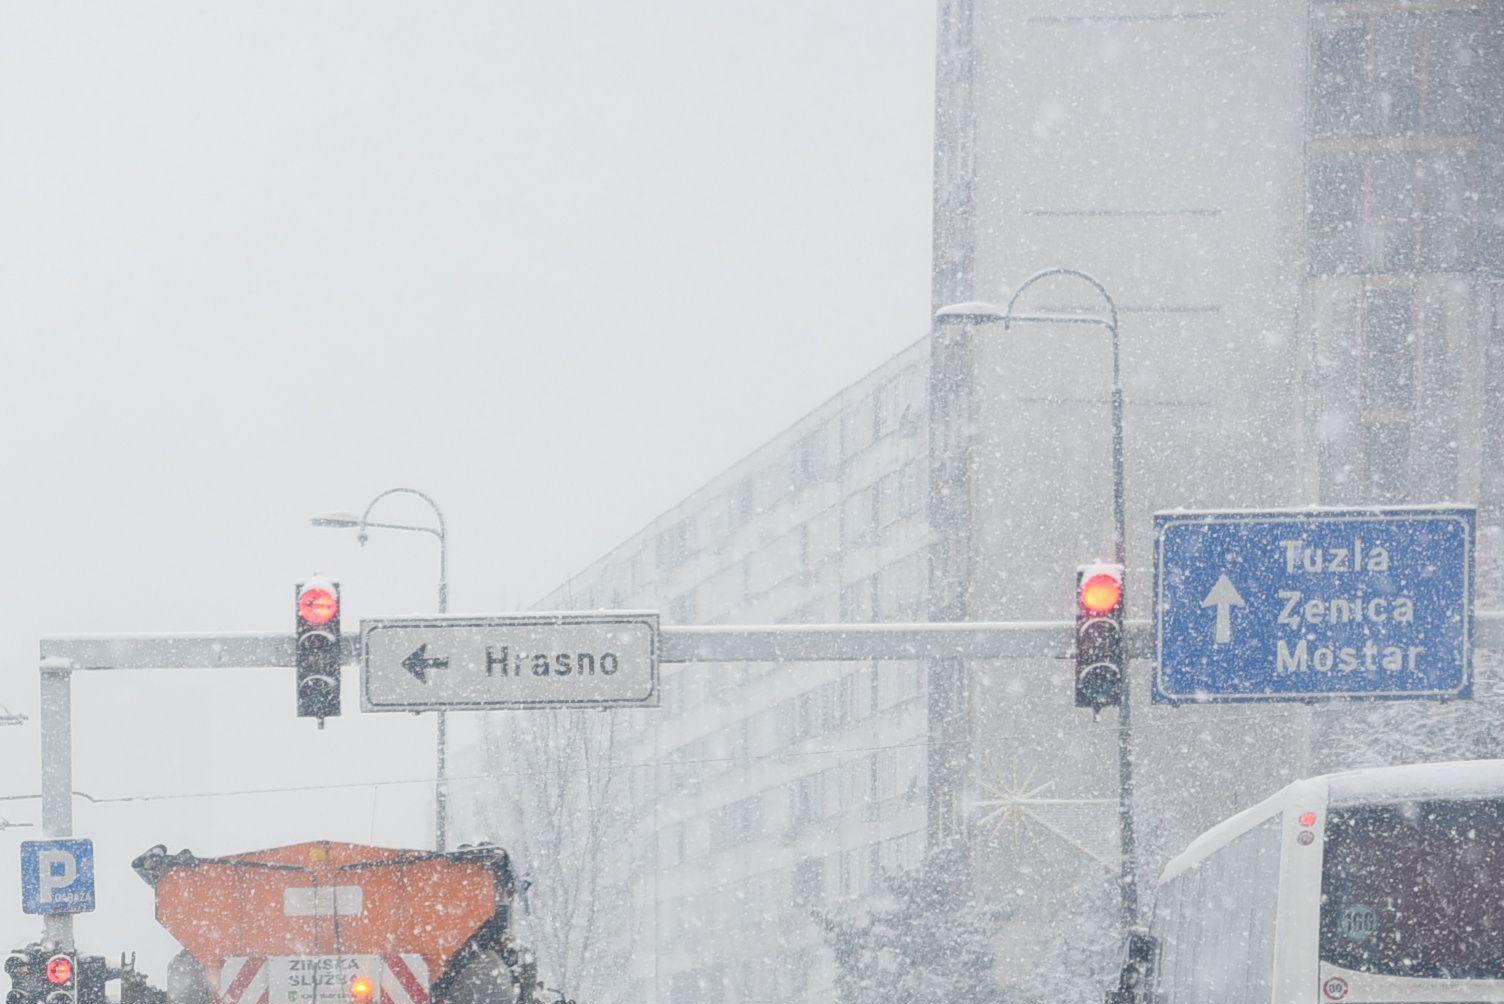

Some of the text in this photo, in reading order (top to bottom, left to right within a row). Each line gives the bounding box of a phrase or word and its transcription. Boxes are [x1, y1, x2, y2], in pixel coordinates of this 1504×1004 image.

[1279, 538, 1390, 575] Tuzla
[1277, 589, 1415, 626] Zenica
[484, 645, 619, 678] Hrasno
[1275, 638, 1426, 674] Mostar
[38, 850, 77, 903] P
[1344, 912, 1374, 931] 100
[289, 958, 360, 971] ZIMSKA
